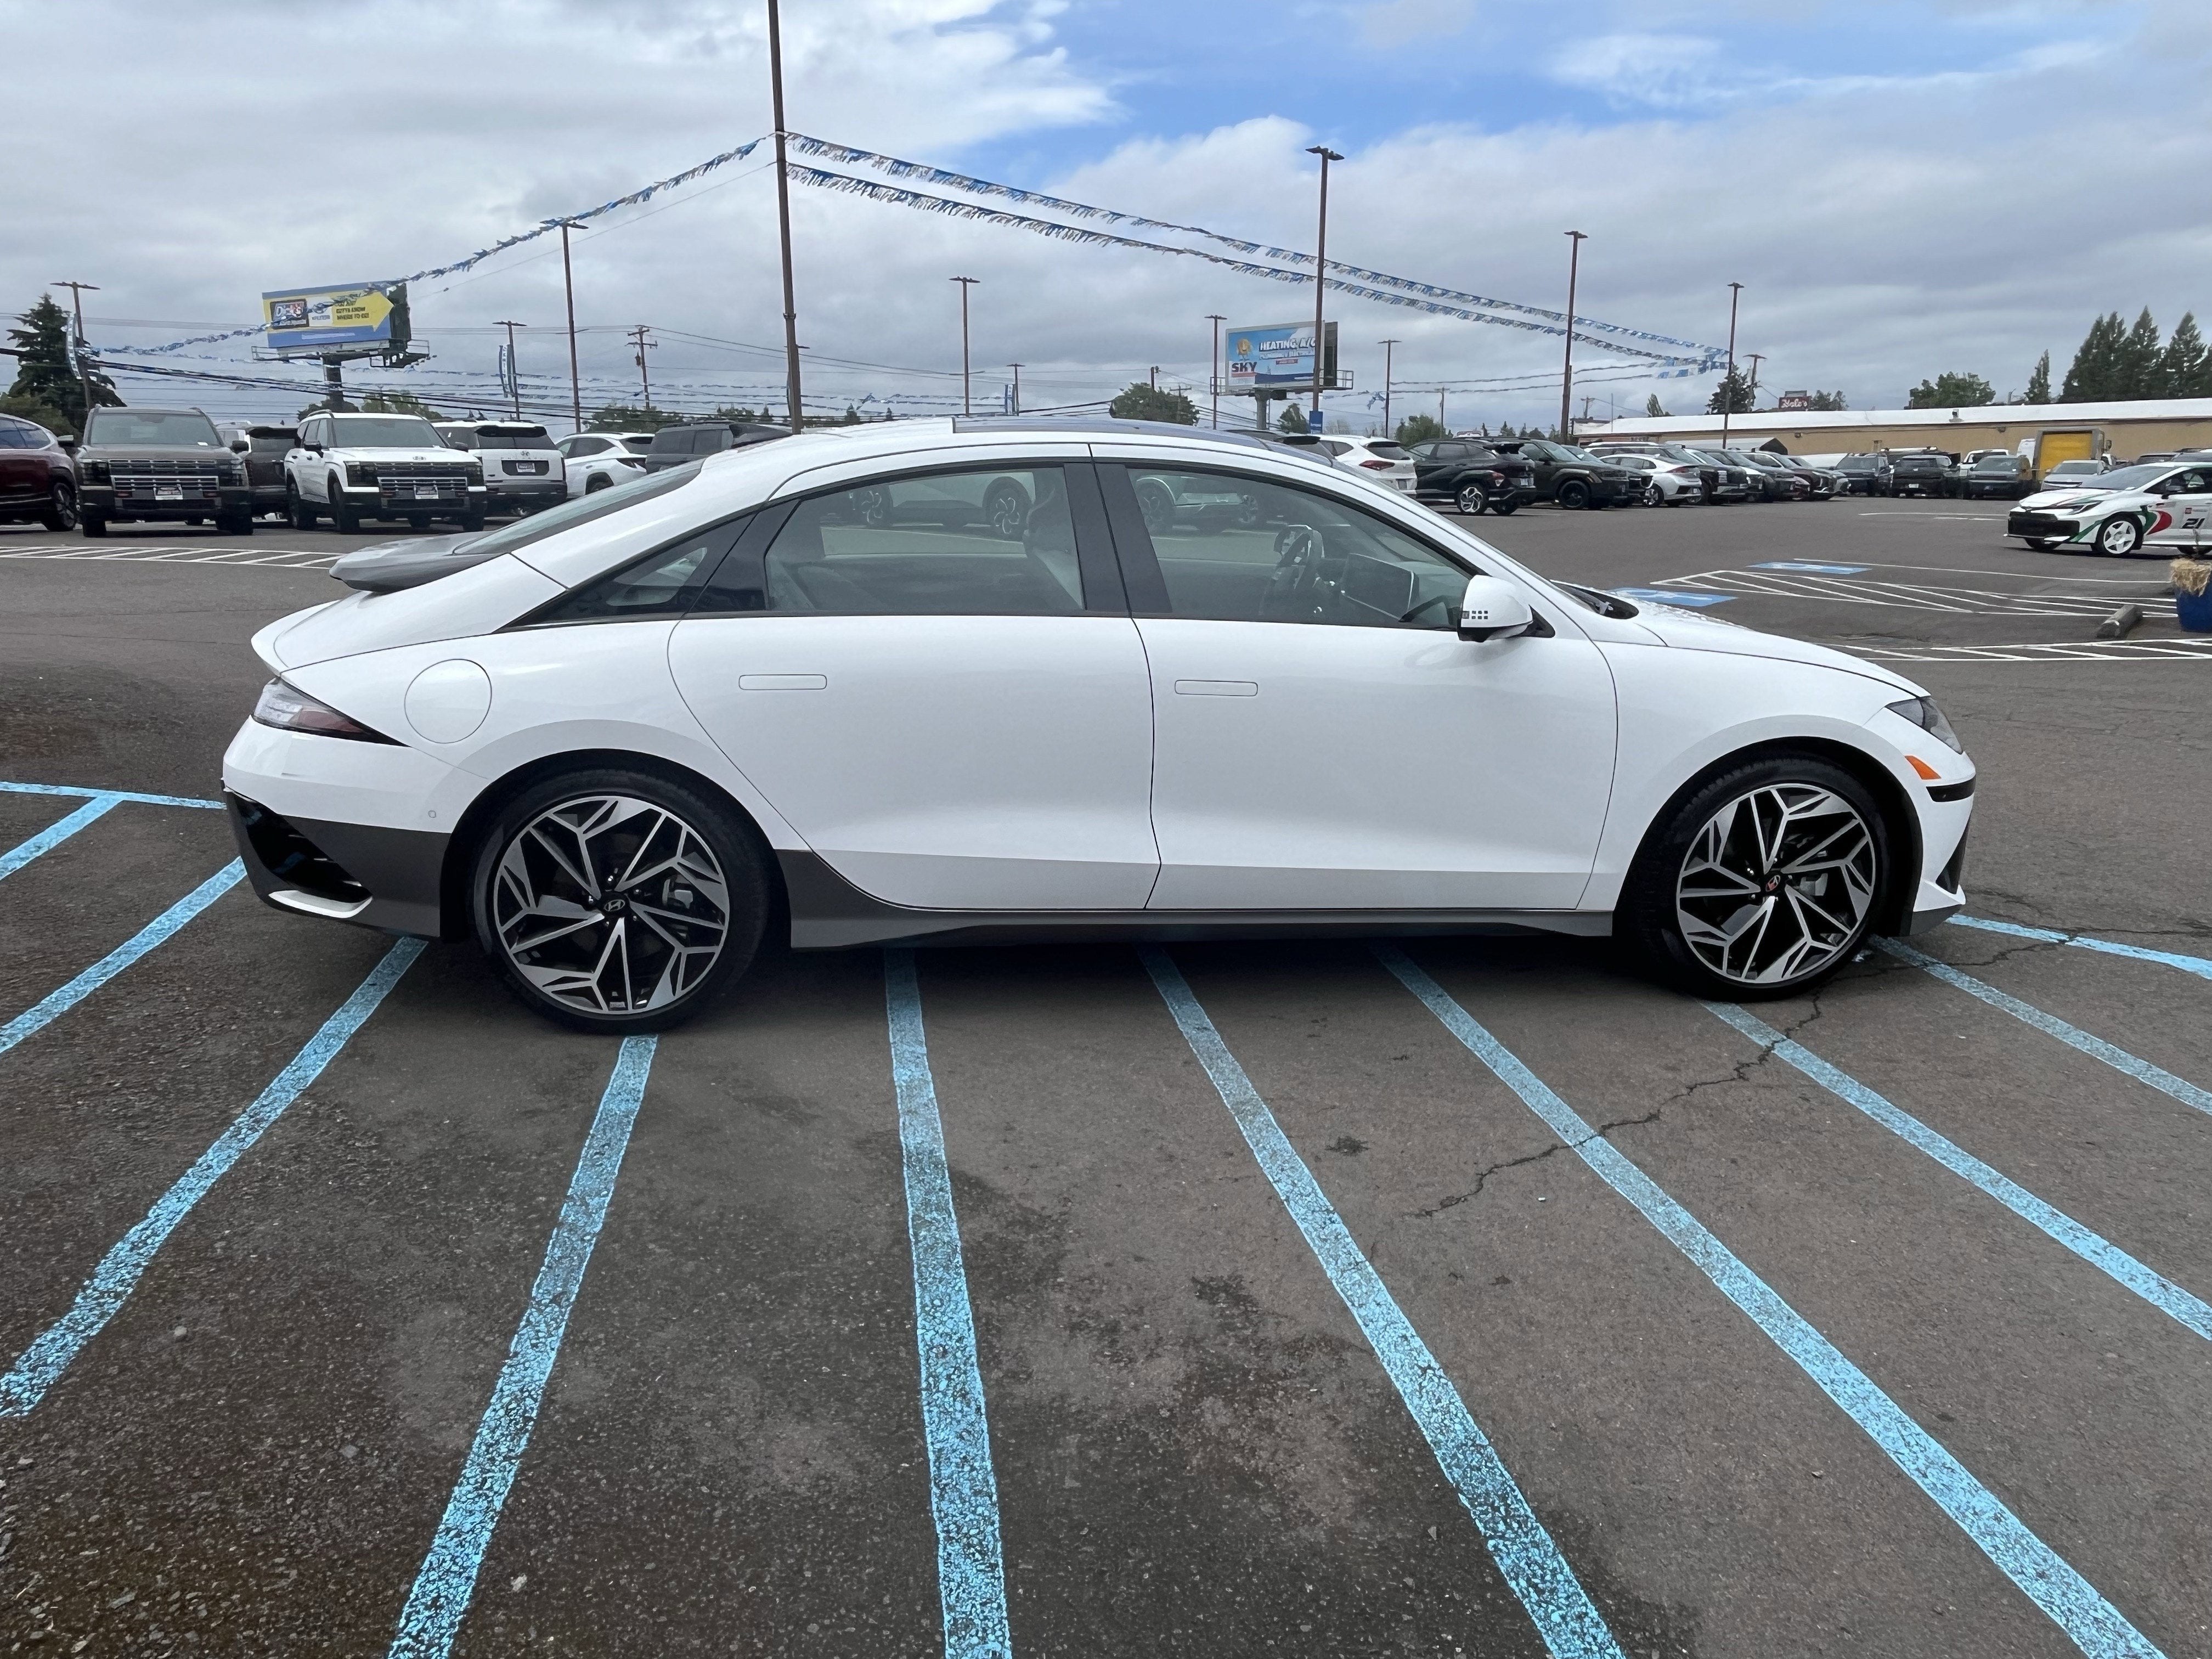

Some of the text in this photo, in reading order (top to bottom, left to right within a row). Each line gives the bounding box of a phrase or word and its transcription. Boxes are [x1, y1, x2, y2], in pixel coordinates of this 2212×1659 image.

[1259, 339, 1297, 351] HEATING
[1231, 362, 1257, 373] SKY
[2181, 518, 2205, 529] 21
